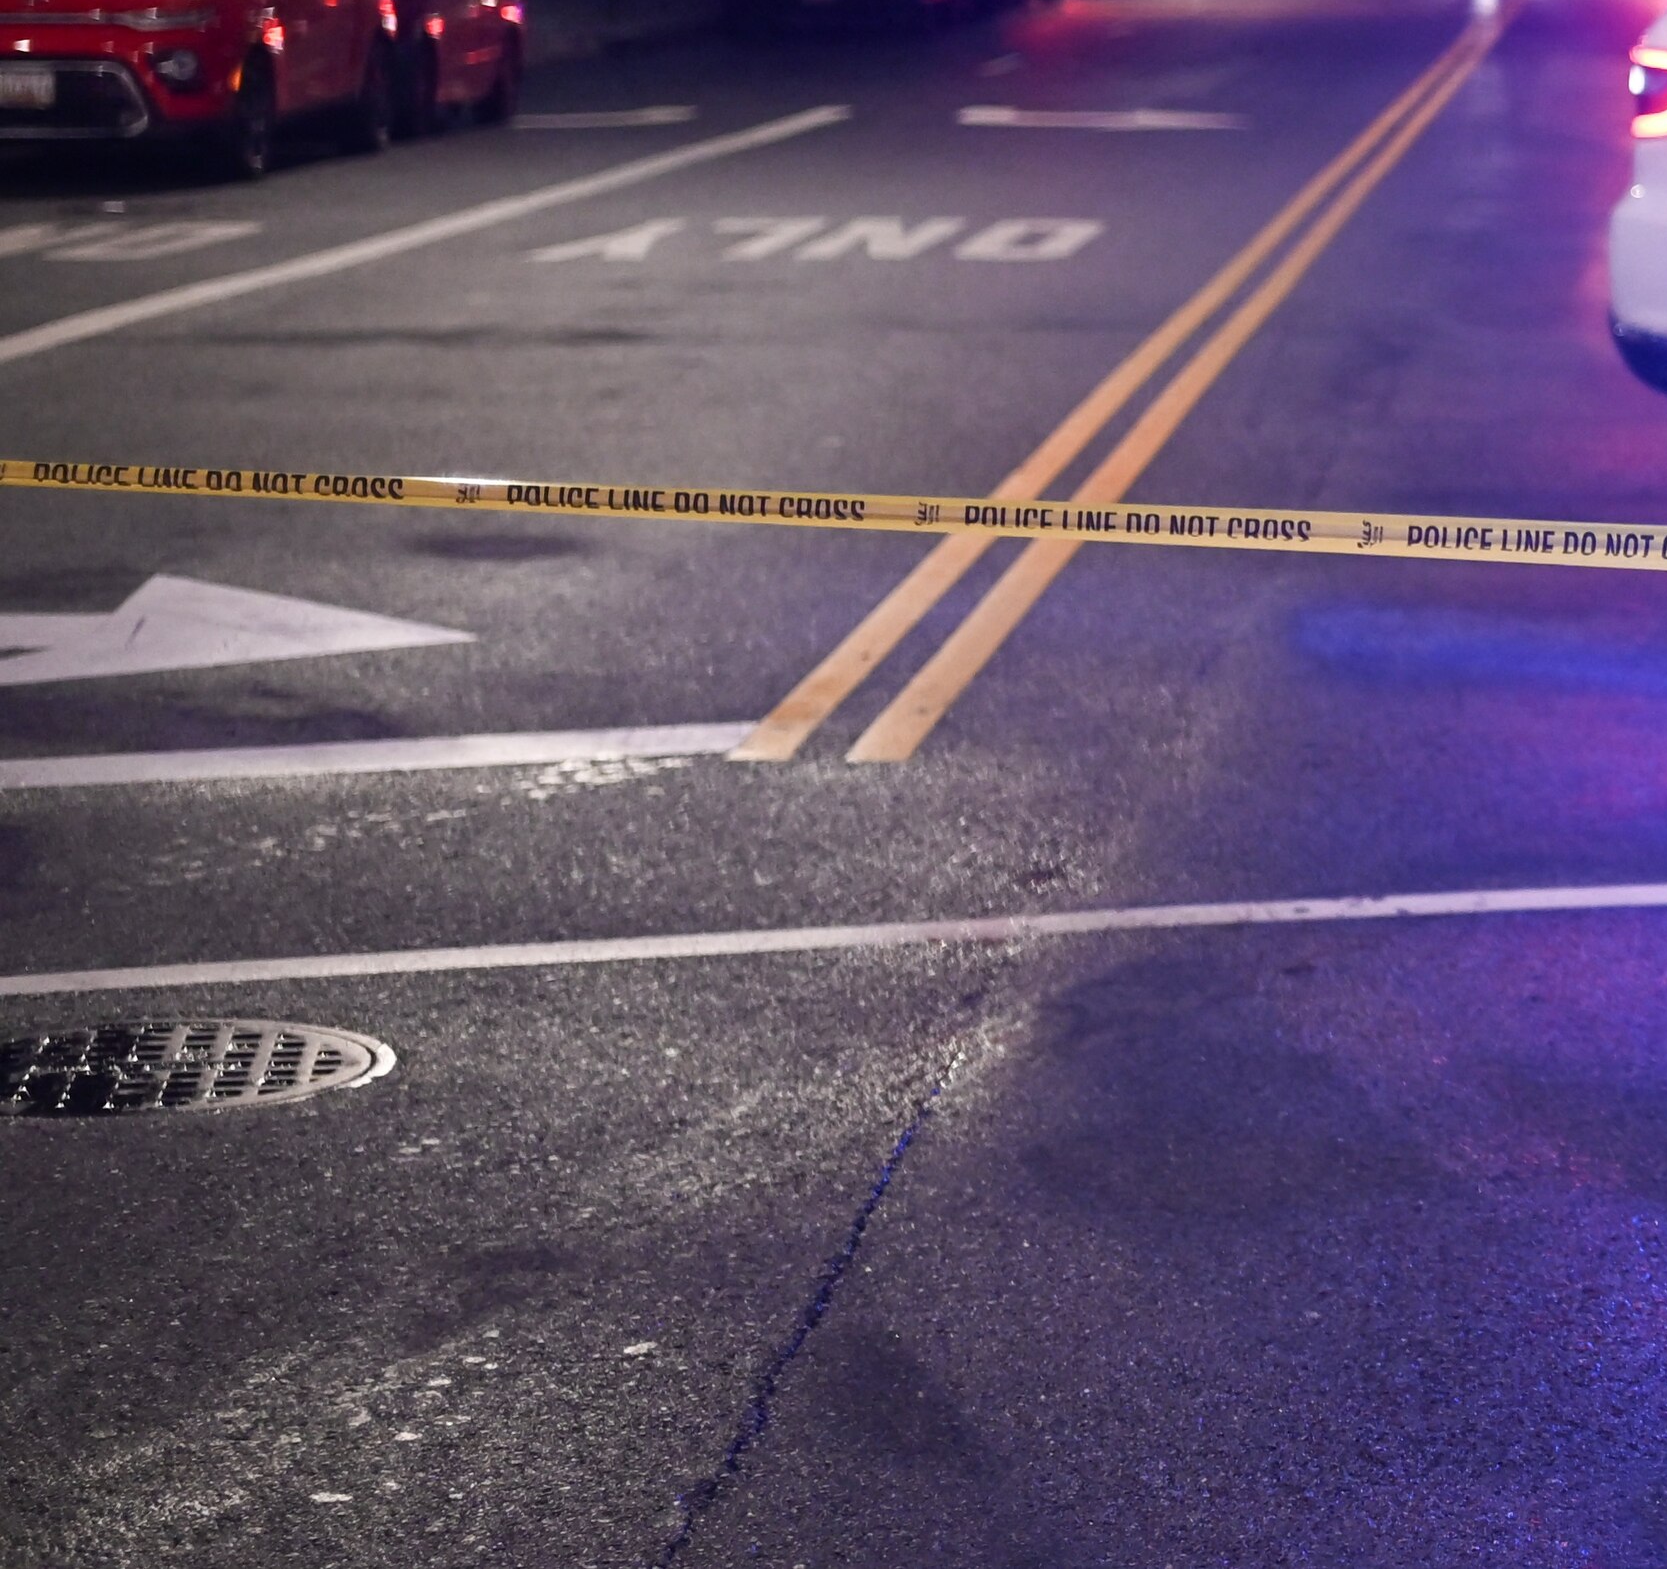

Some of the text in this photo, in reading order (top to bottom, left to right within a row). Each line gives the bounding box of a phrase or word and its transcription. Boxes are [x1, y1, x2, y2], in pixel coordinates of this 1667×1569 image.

[33, 463, 404, 500] POLICE LINE DO NOT CROSS
[507, 485, 599, 508] POLICE
[608, 489, 665, 513] LINE
[674, 493, 709, 515] DO
[720, 494, 771, 517] NOT
[779, 497, 865, 521] CROSS
[965, 505, 1053, 528] POLICE
[1063, 510, 1117, 532] LINE
[1126, 513, 1160, 534] DO
[1170, 514, 1219, 537] NOT
[1228, 517, 1311, 542] CROSS
[1407, 525, 1493, 551] POLICE
[1501, 530, 1555, 554] LINE
[1563, 532, 1596, 556] DO
[1605, 533, 1654, 559] NOT
